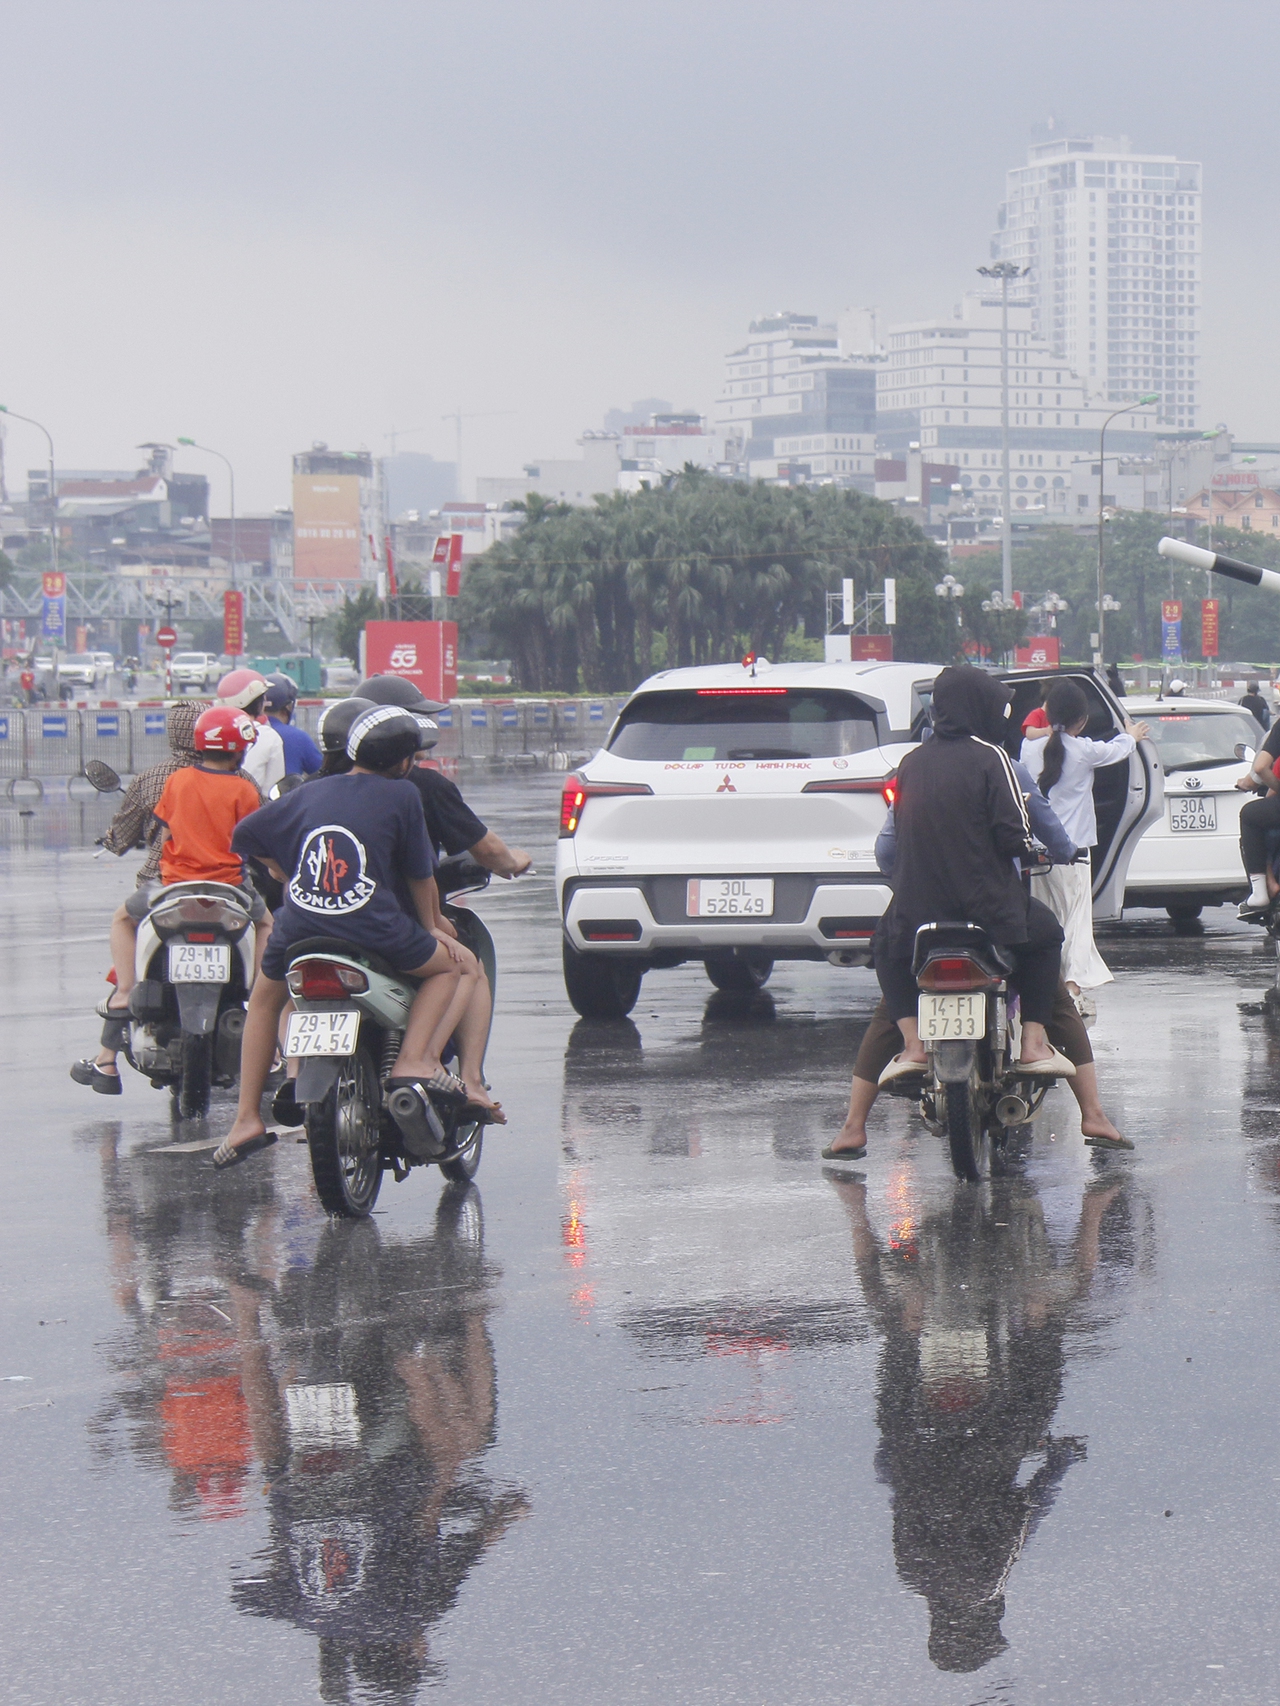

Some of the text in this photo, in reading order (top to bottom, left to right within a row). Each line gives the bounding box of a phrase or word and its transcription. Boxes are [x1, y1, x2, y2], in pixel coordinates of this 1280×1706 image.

[1227, 473, 1260, 485] HOTEL
[390, 650, 417, 668] 5G
[1031, 652, 1047, 664] 5G
[1181, 799, 1205, 813] 30A
[1172, 814, 1215, 829] 552.94
[292, 882, 372, 909] MONCLER
[720, 881, 752, 896] 30L
[707, 898, 764, 914] 526.49
[179, 947, 221, 963] 29-M1
[174, 964, 226, 980] 449.53
[931, 997, 973, 1016] 14-F1
[298, 1013, 348, 1033] 29-V7
[928, 1017, 975, 1037] 5733
[291, 1033, 351, 1054] 374.54
